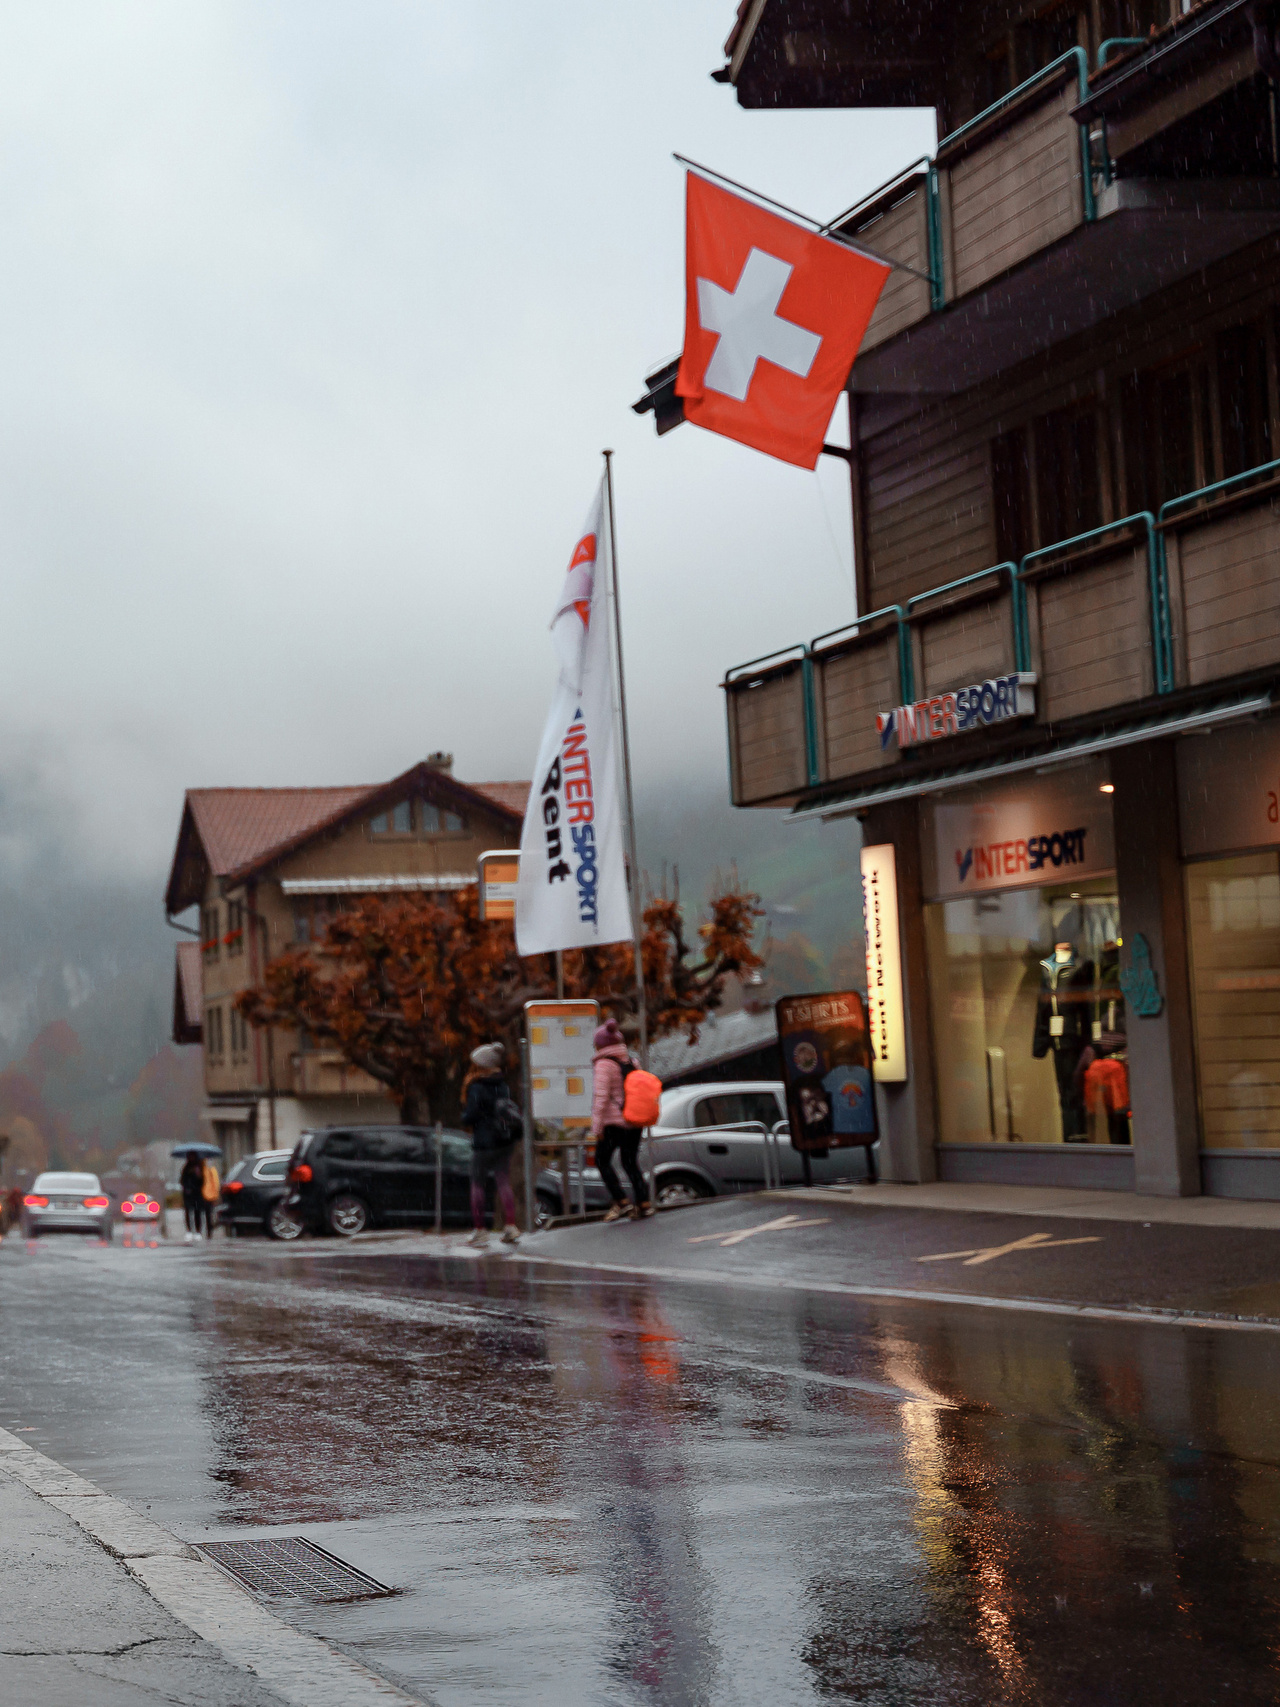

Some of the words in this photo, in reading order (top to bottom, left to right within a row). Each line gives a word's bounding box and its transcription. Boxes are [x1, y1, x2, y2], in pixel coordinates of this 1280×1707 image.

[897, 672, 1021, 748] INTERSPORT
[541, 754, 571, 885] Rent
[563, 723, 597, 923] INTERSPORT
[973, 827, 1087, 881] INTERSPORT
